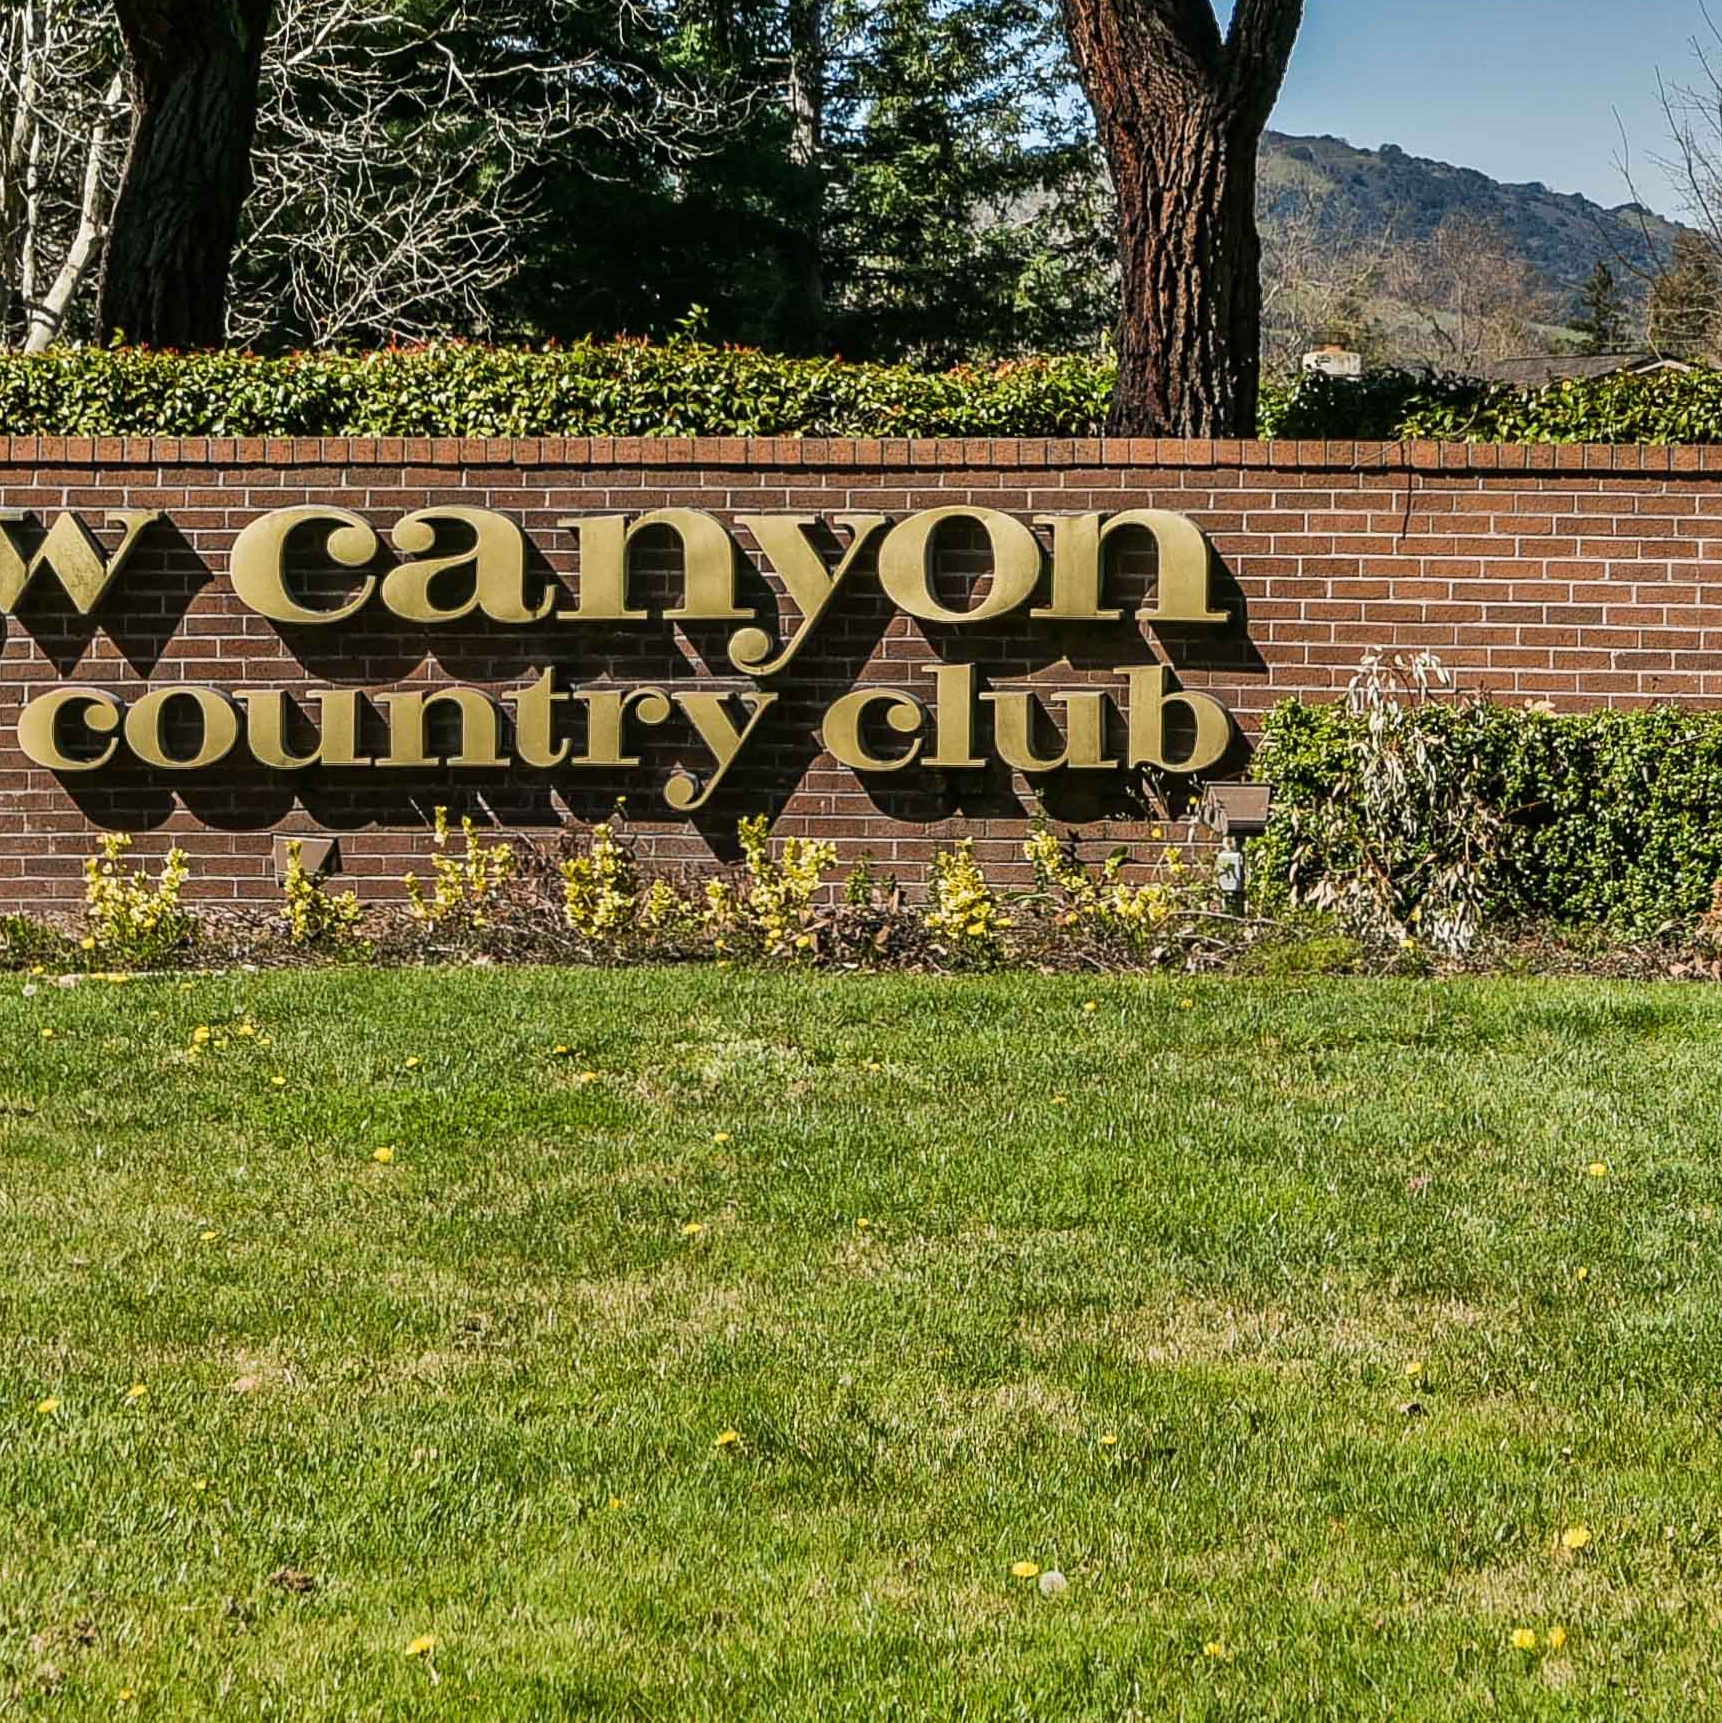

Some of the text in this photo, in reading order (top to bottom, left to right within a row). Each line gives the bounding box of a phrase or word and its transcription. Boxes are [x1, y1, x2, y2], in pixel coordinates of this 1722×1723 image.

[231, 505, 1228, 675] canyon
[18, 664, 1230, 811] country club
